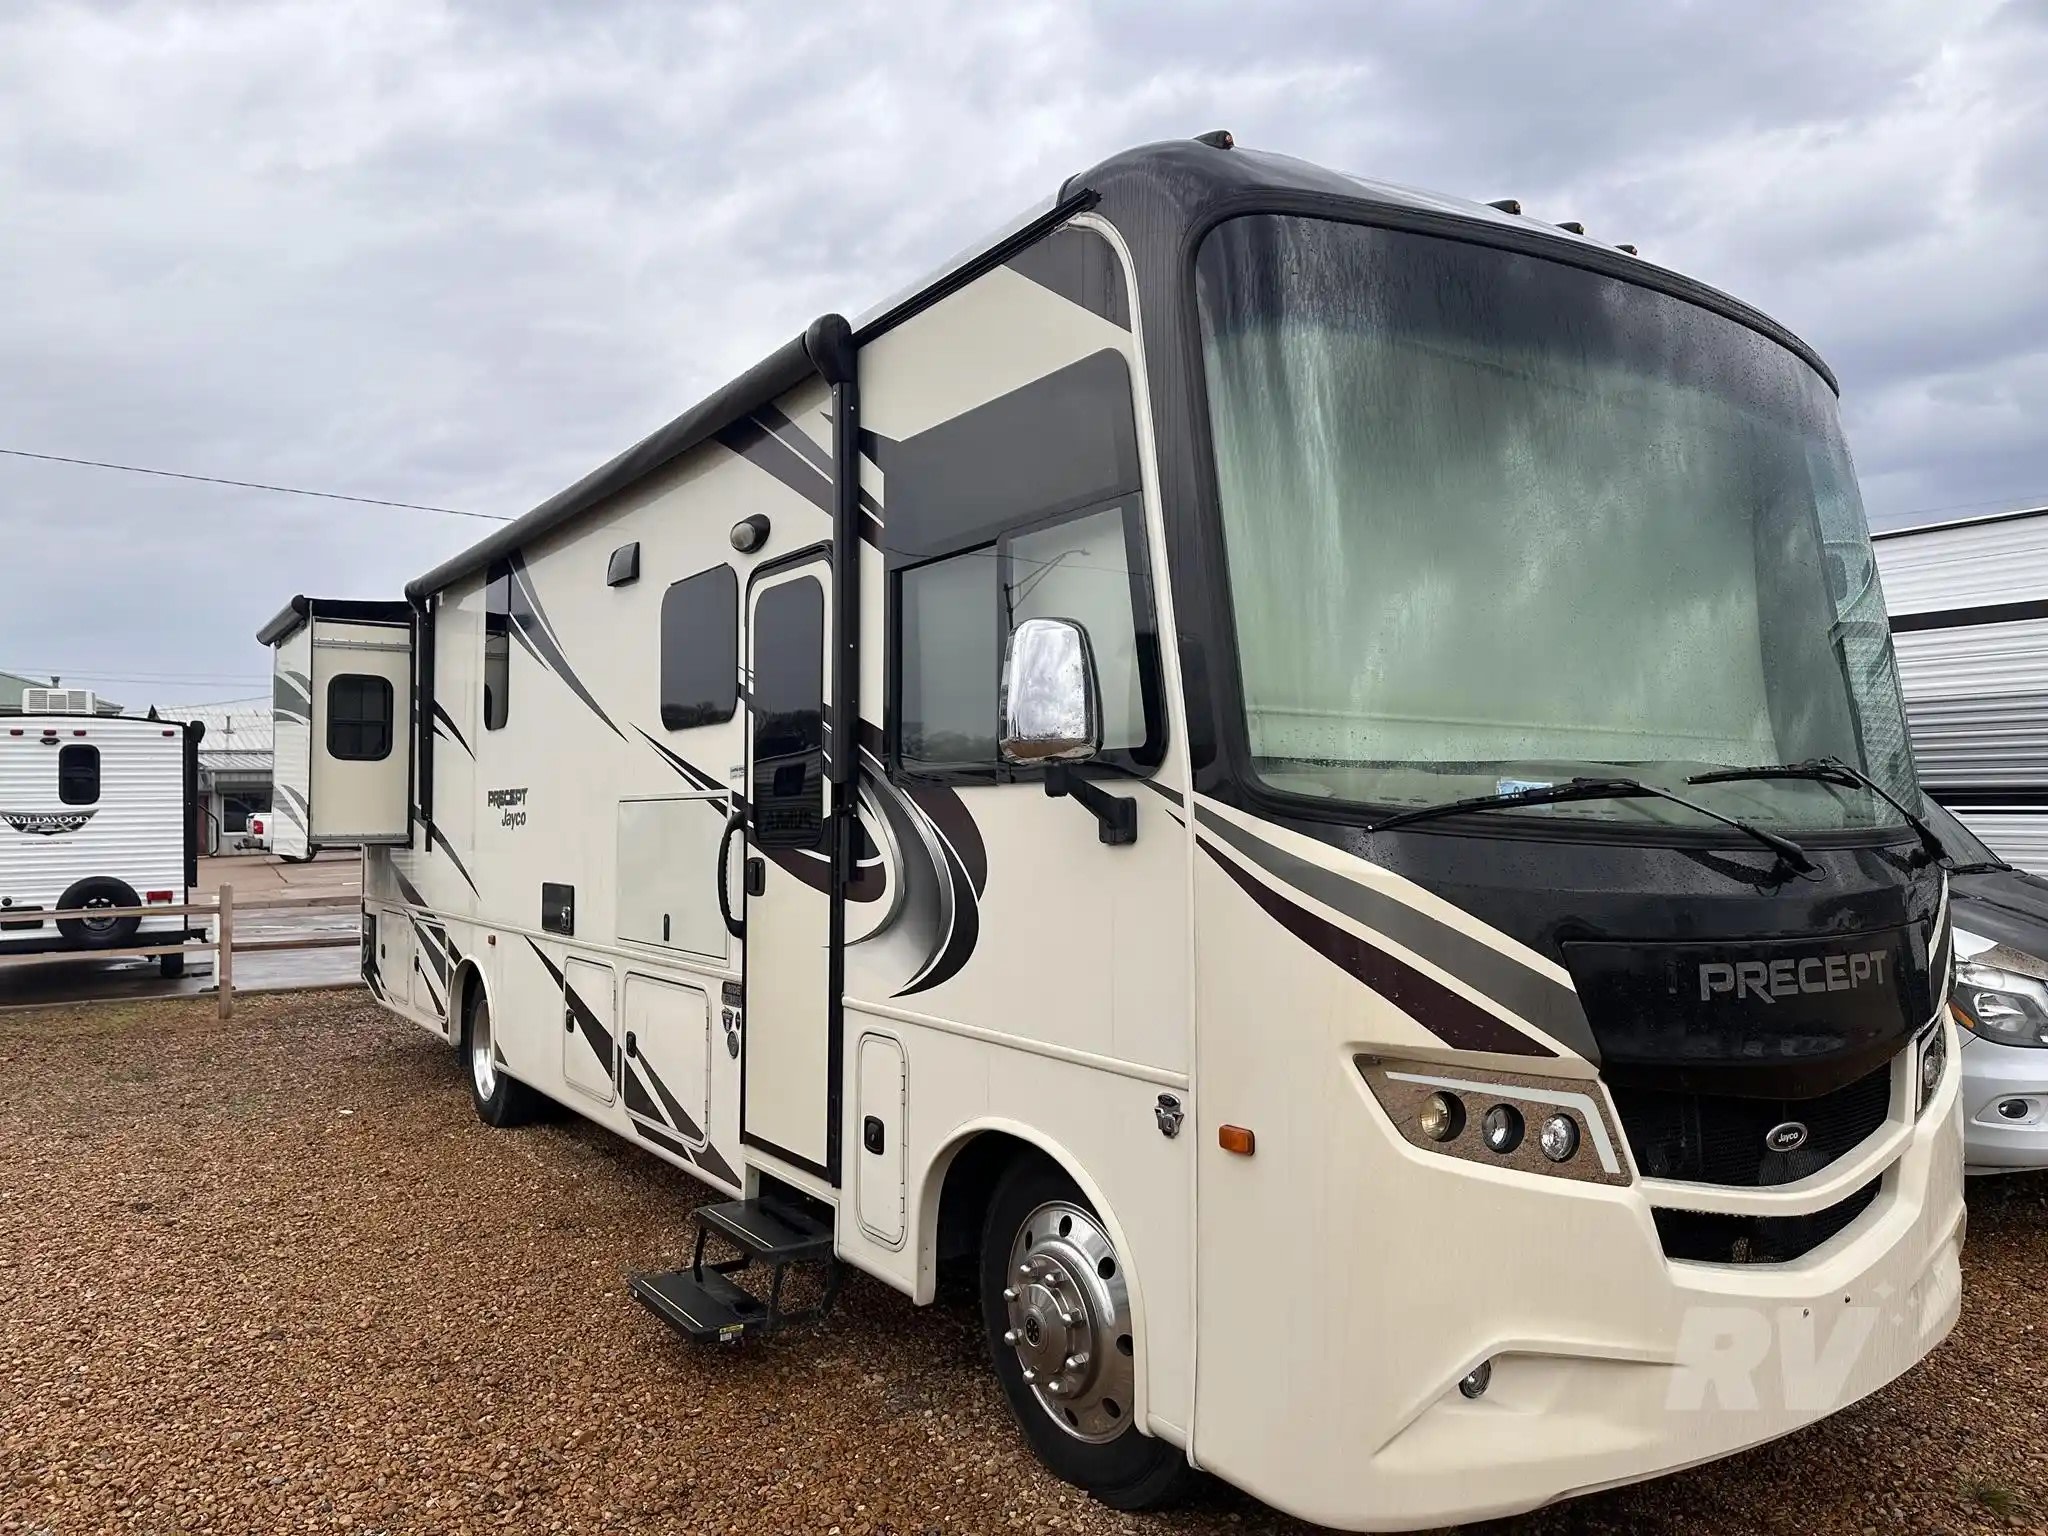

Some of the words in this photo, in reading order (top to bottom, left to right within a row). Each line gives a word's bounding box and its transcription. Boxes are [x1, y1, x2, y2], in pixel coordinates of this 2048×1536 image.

[487, 787, 529, 809] PRECEPT
[5, 816, 89, 824] WILDWOOD
[501, 808, 526, 830] Jayco
[1699, 949, 1888, 1004] PRECEPT
[1778, 1132, 1799, 1143] Jayco
